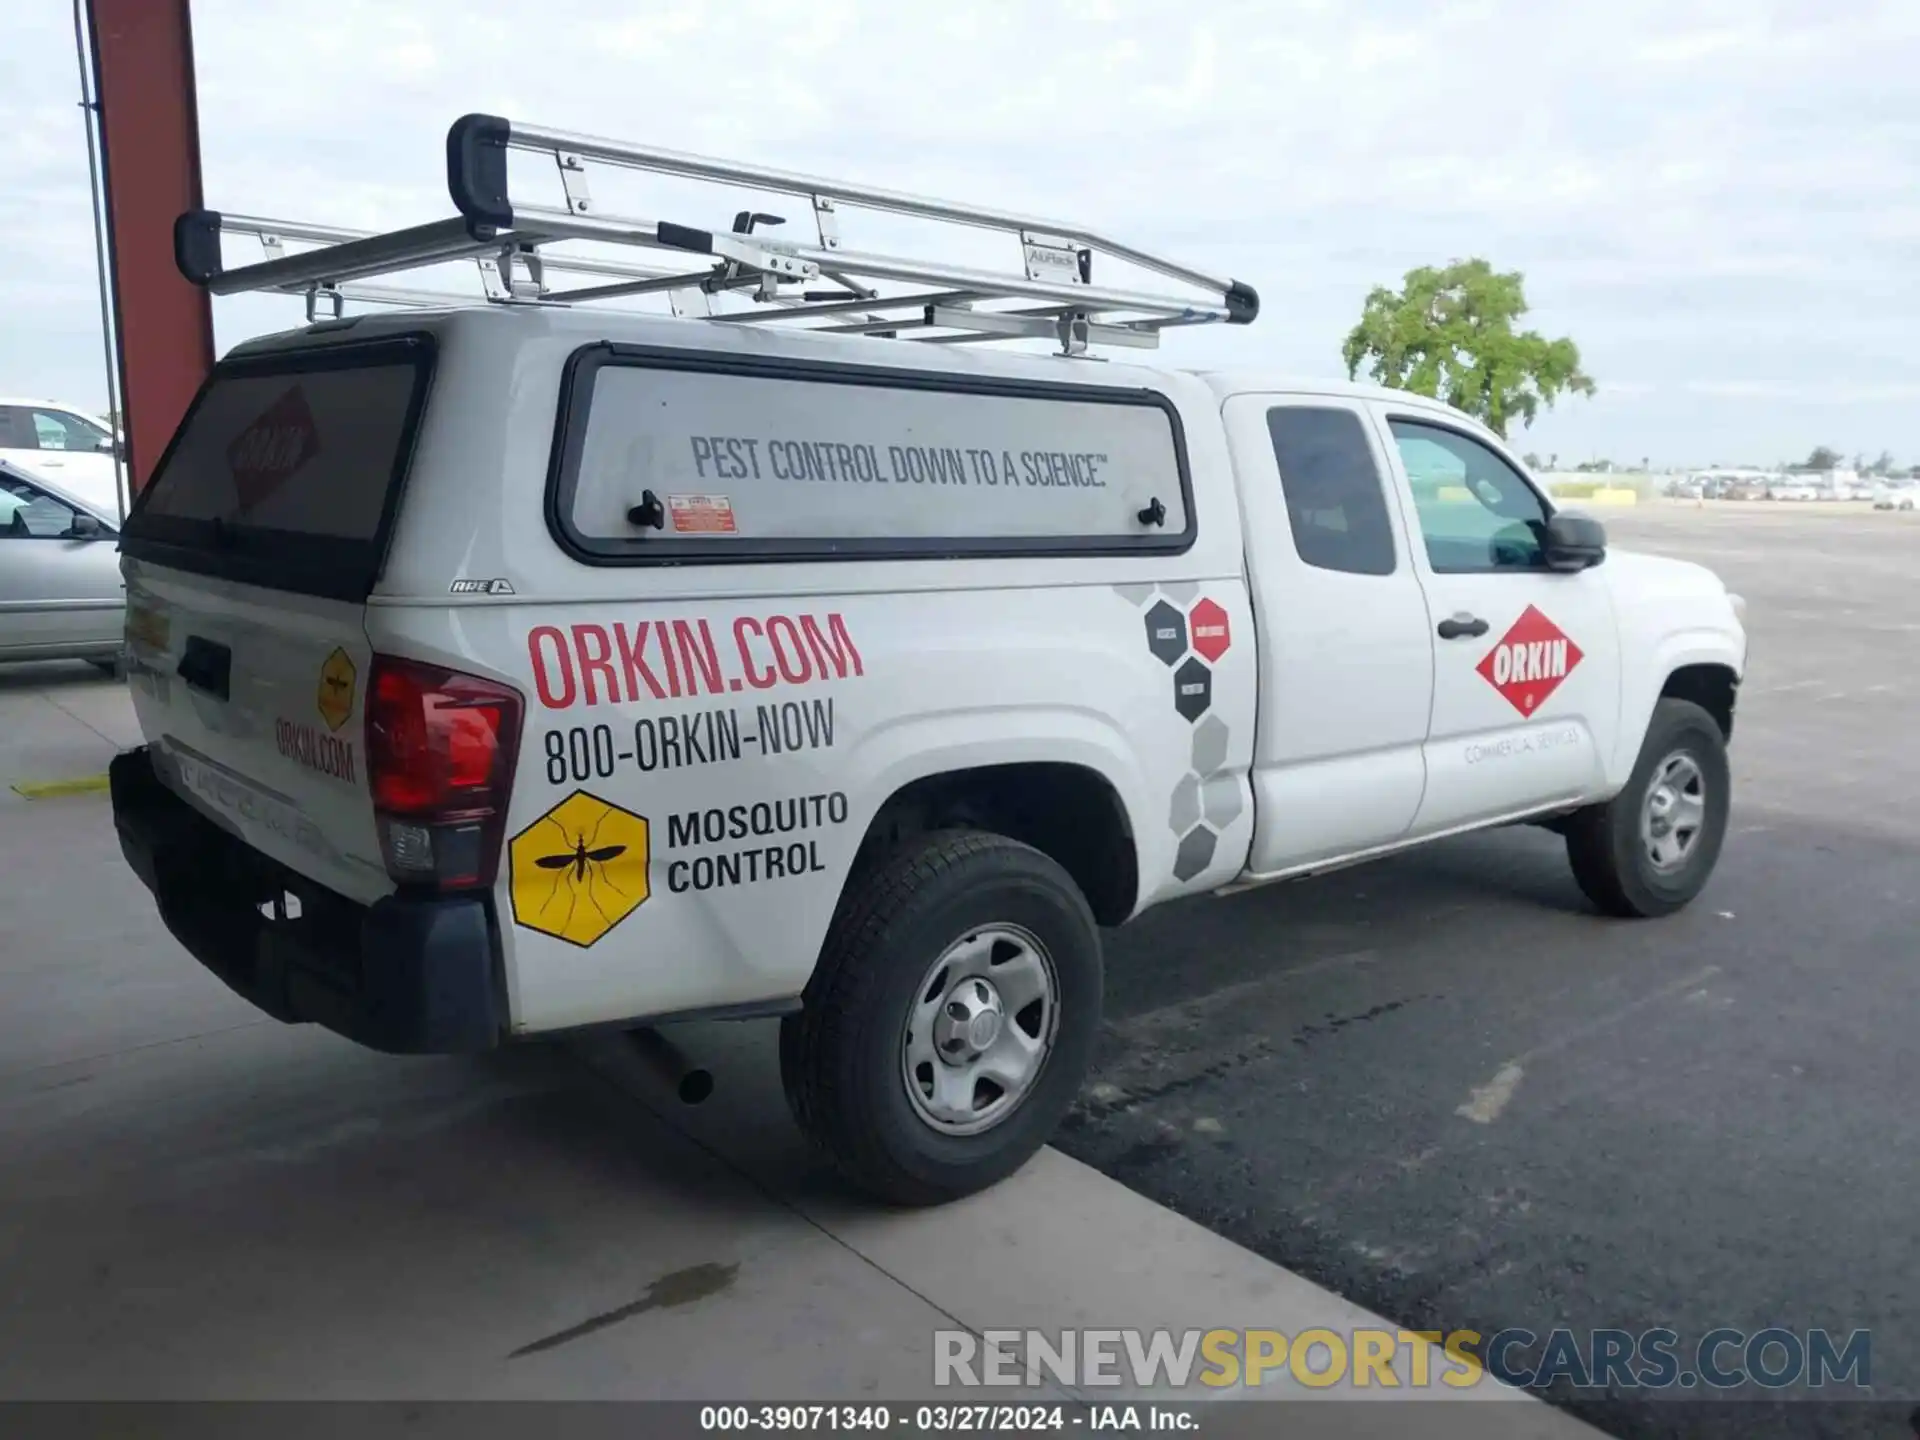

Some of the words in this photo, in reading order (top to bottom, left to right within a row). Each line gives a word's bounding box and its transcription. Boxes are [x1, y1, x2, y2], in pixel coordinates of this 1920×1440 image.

[690, 435, 761, 479] PEST
[768, 440, 889, 483] CONTROL
[889, 446, 967, 486] DOWN
[966, 448, 998, 486] TO
[1001, 450, 1021, 487] A
[528, 613, 864, 709] ORKIN.COM
[1493, 639, 1568, 685] ORKIN
[275, 717, 356, 785] ORKIN.COM
[545, 698, 834, 785] 800-ORKIN-NOW
[1464, 736, 1535, 764] COMMERCA
[667, 791, 848, 848] MOSQUITO
[667, 841, 825, 893] CONTROL
